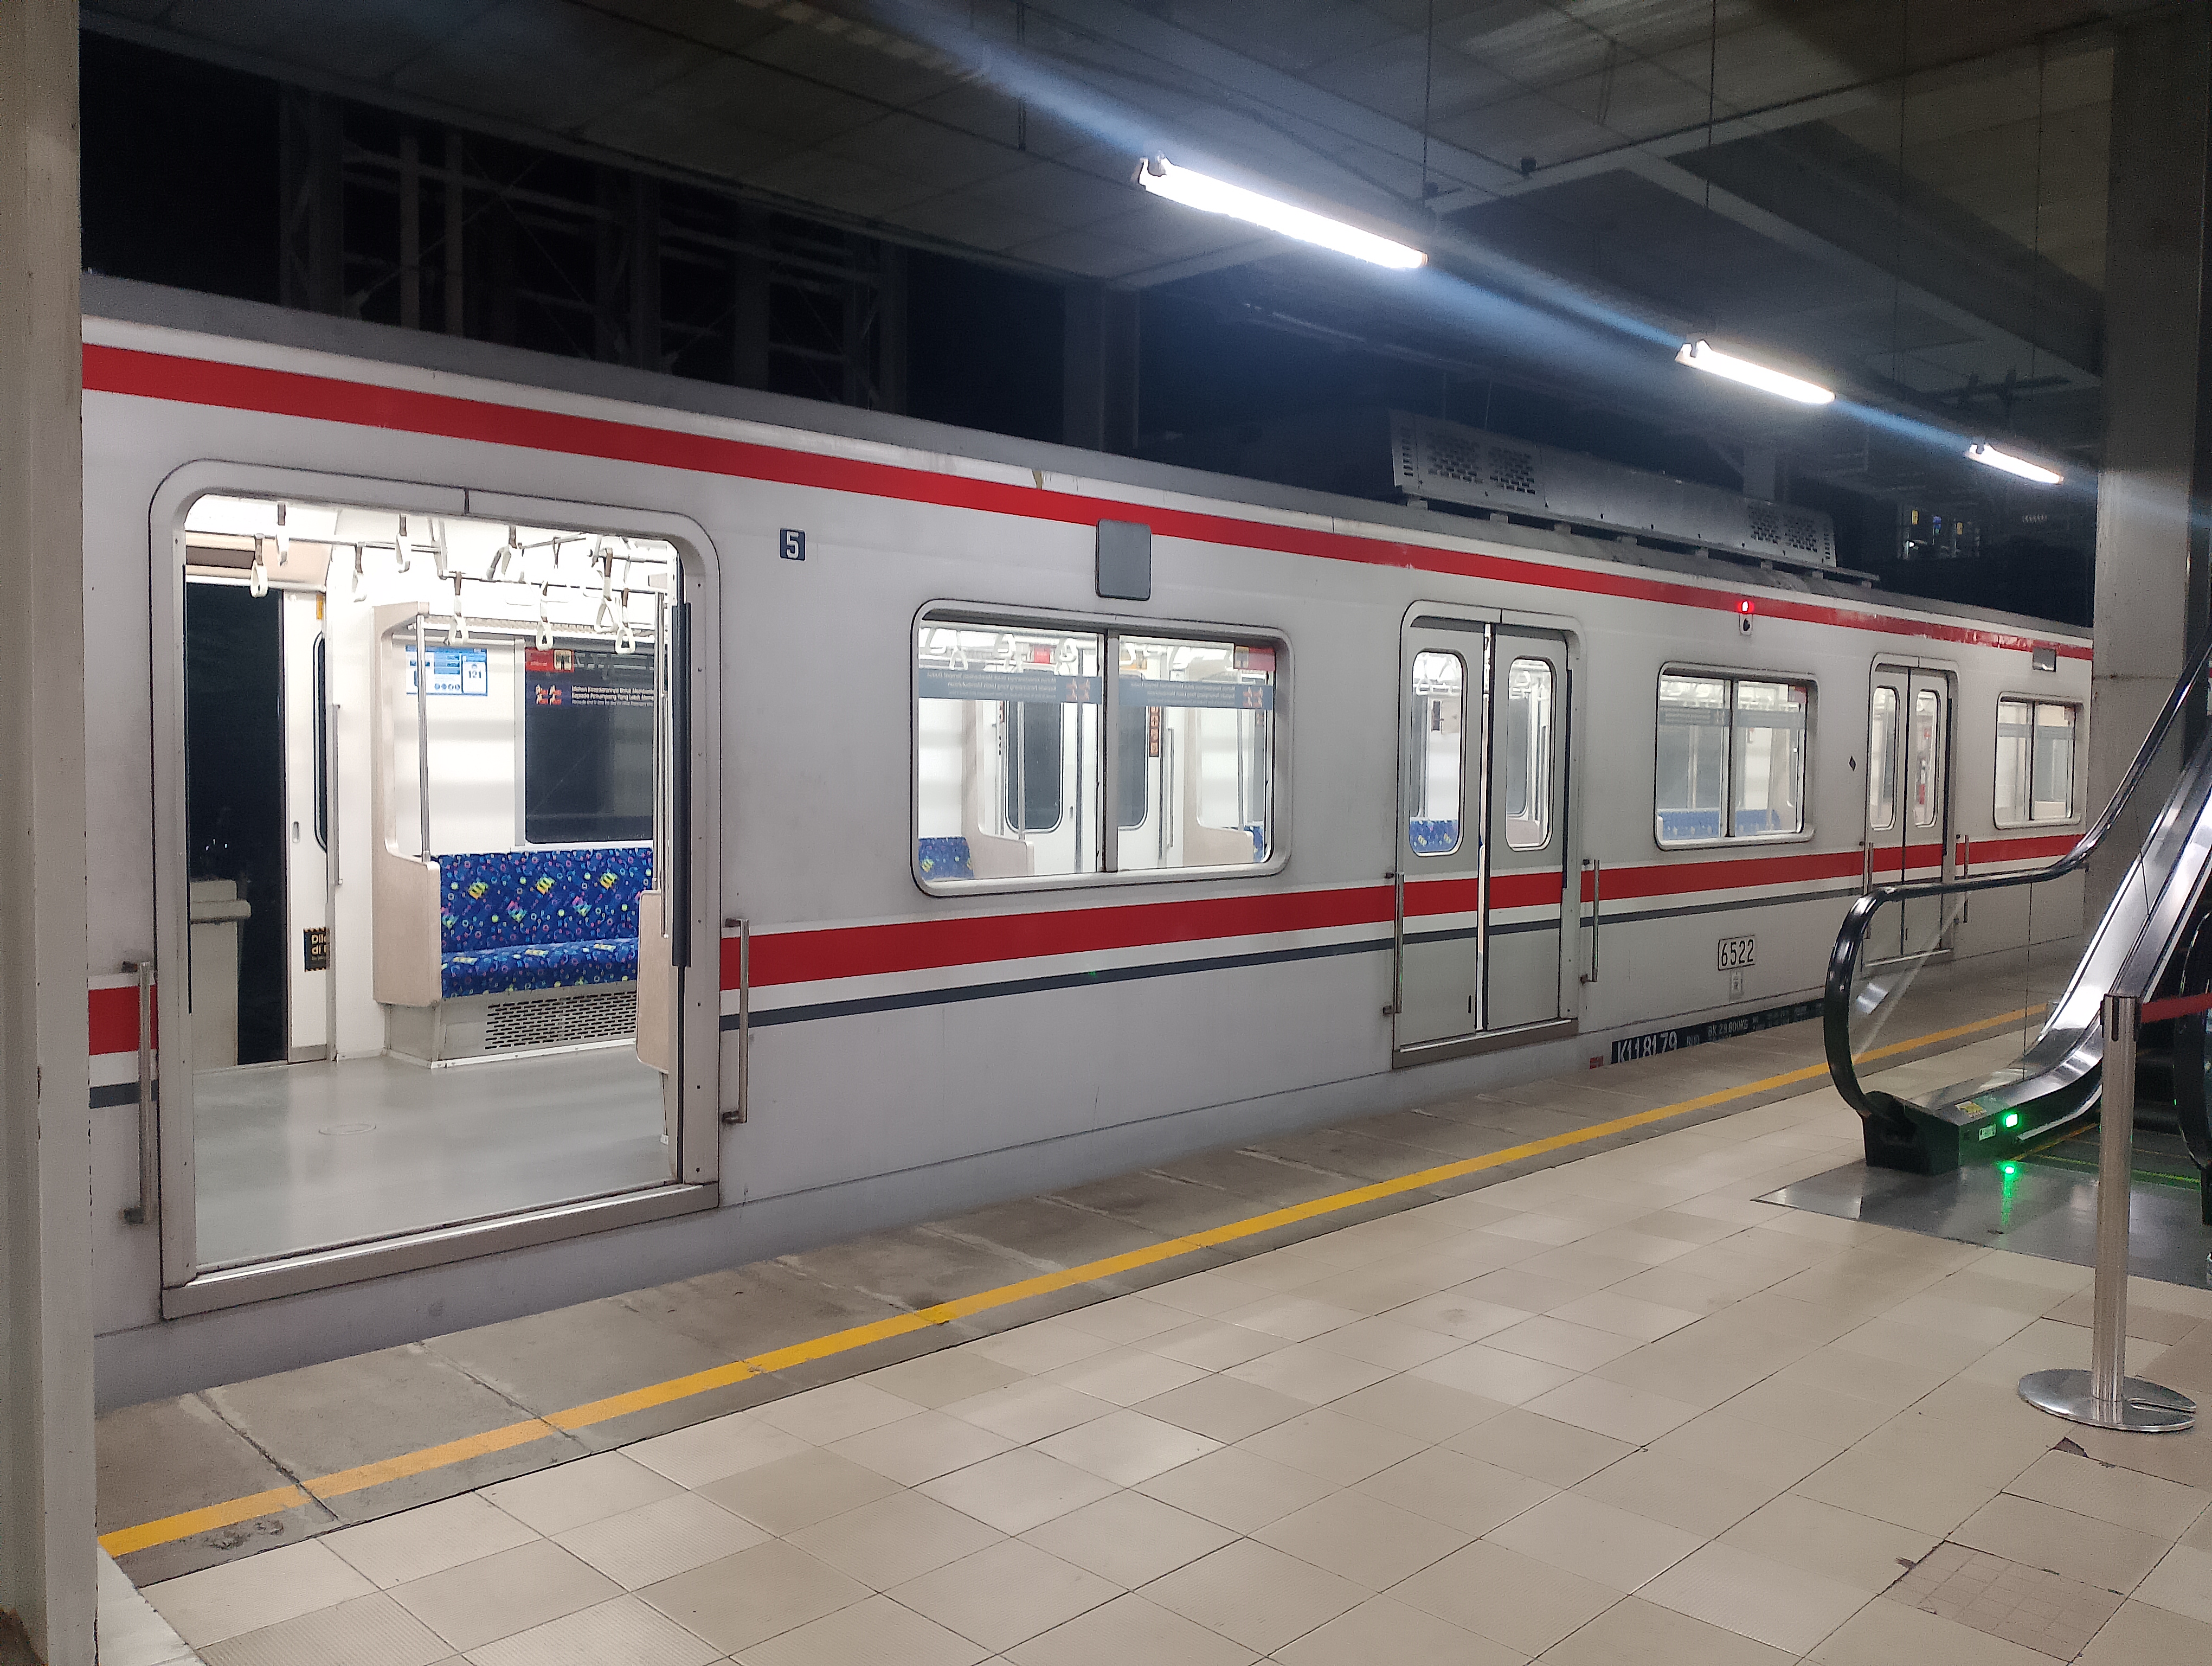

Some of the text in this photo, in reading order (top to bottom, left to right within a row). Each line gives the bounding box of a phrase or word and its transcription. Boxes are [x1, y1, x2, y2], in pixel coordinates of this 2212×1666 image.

[786, 531, 799, 559] 5
[468, 670, 481, 678] 121
[1721, 939, 1754, 967] 6522
